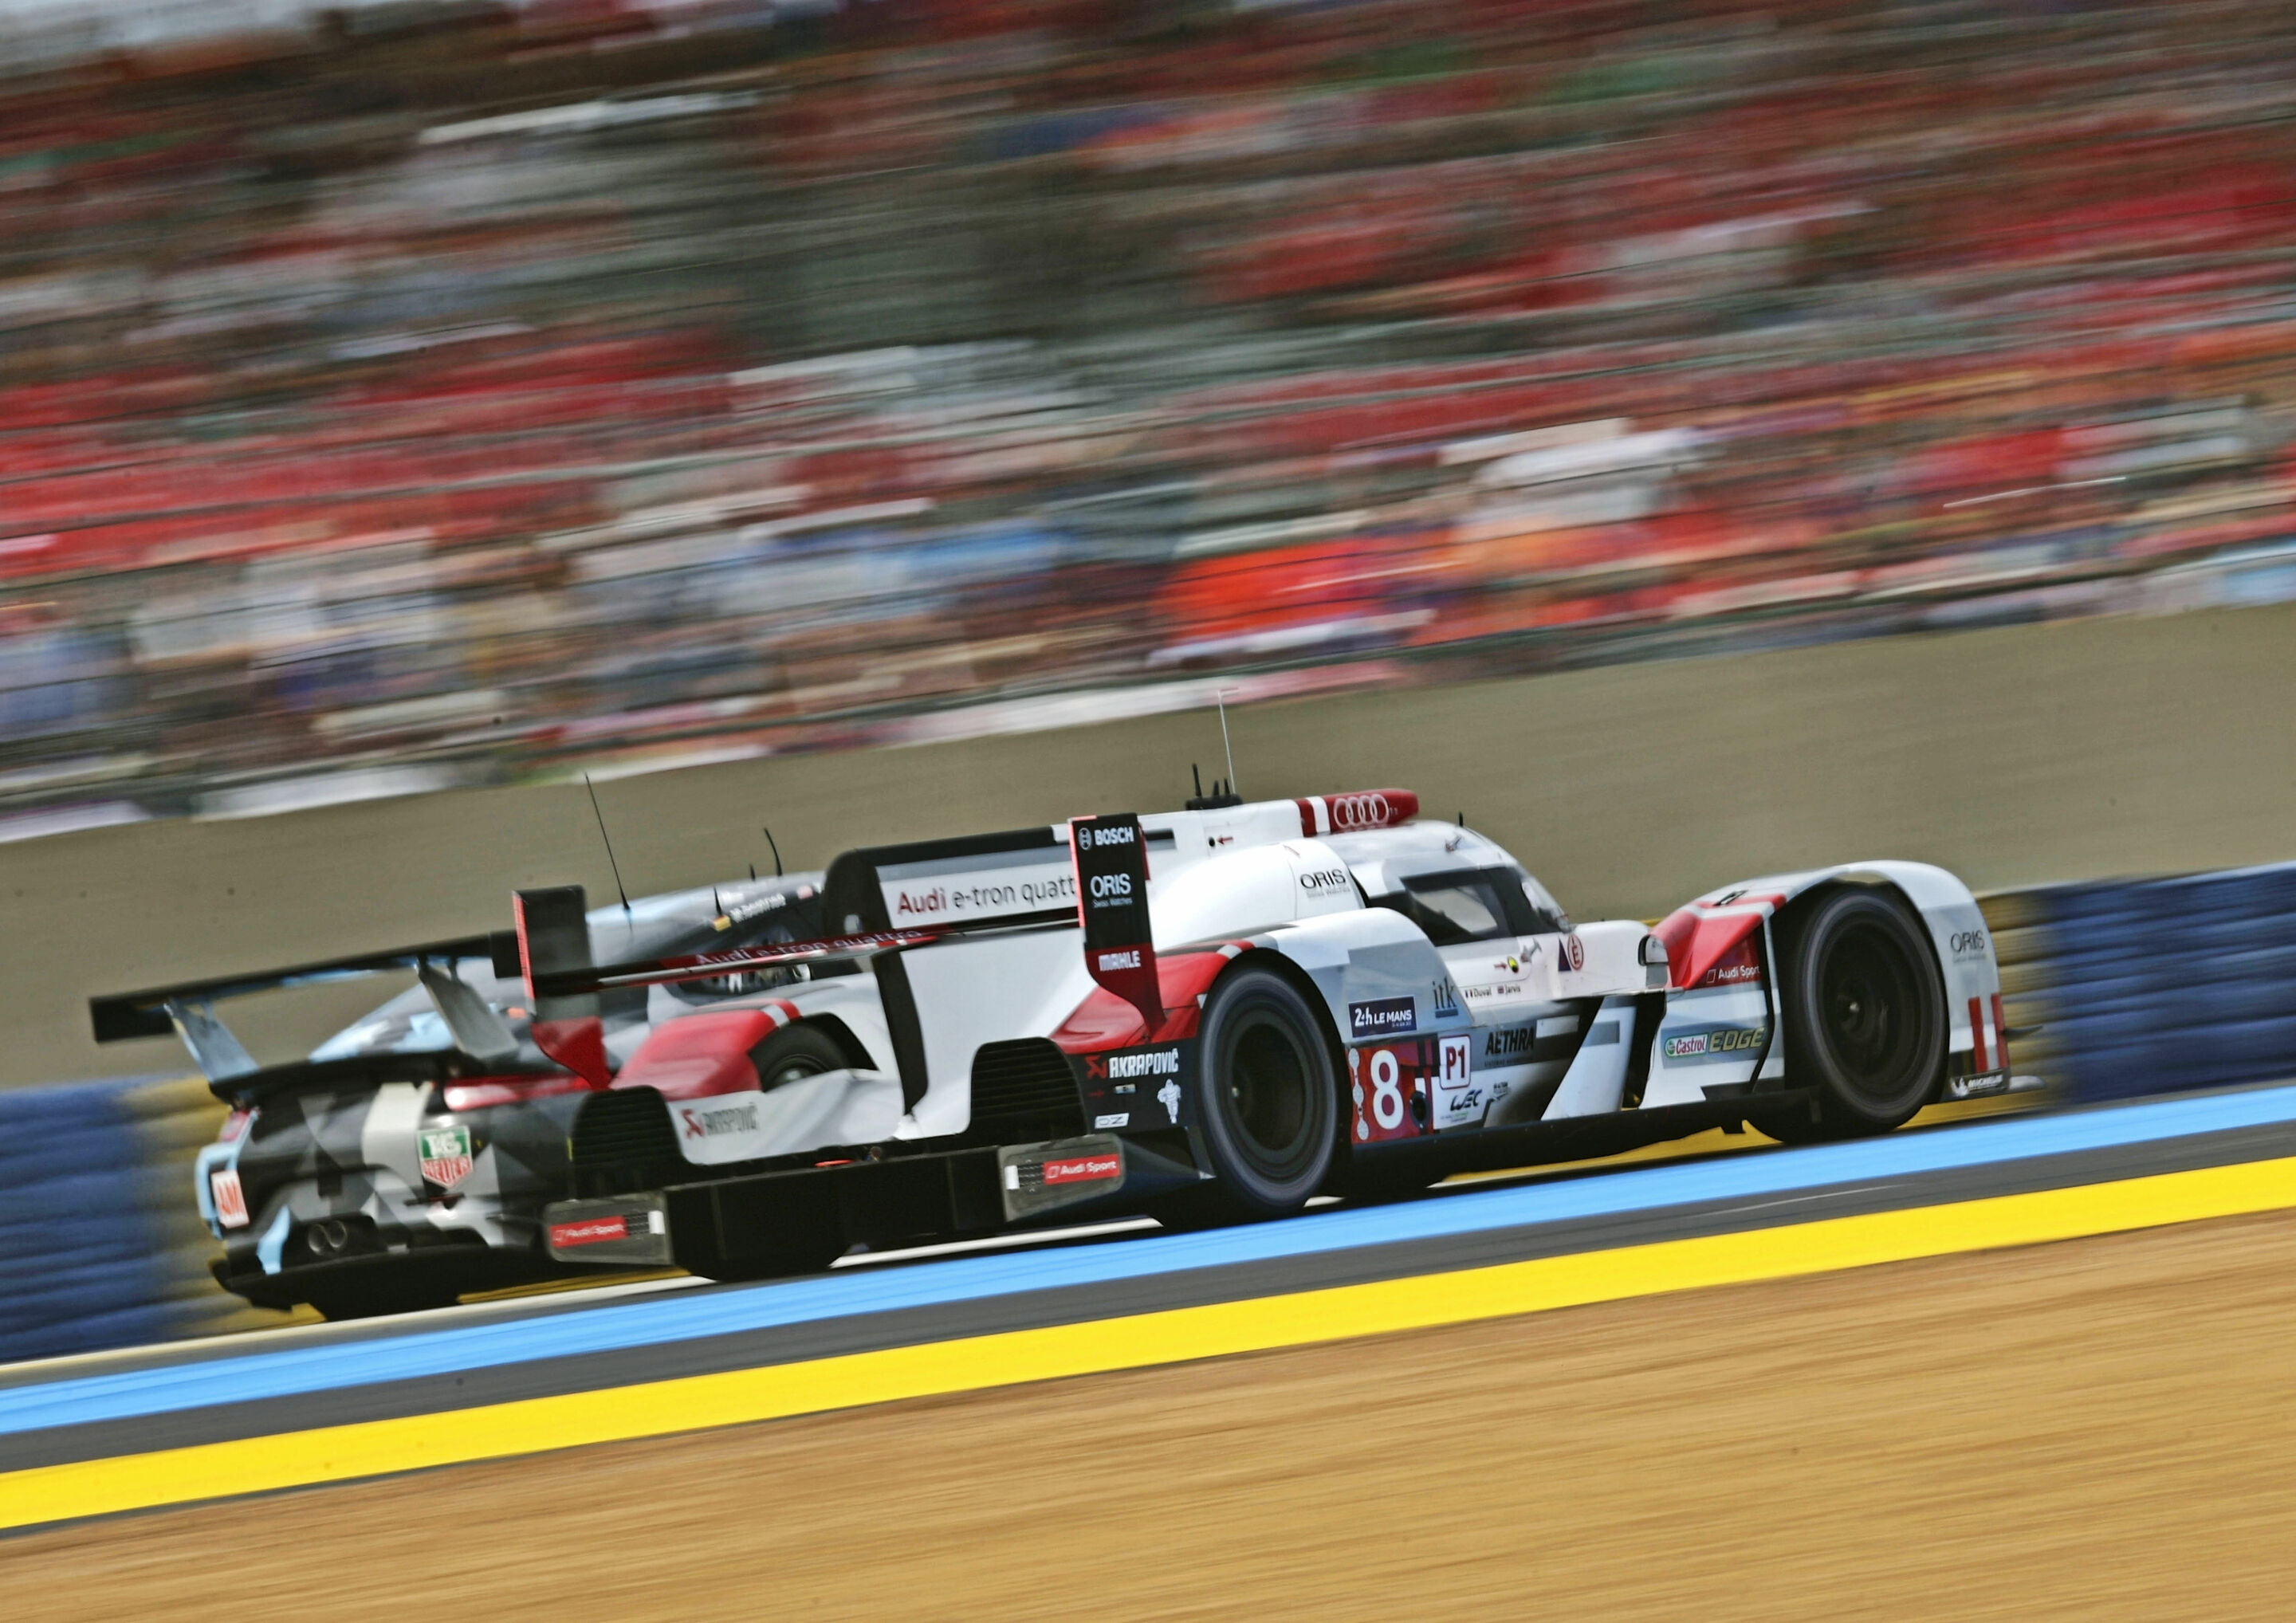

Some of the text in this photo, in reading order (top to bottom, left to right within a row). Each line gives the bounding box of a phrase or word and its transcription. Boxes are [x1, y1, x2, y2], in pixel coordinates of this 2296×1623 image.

[1095, 827, 1134, 846] BOSCH
[1090, 873, 1131, 898] ORIS
[1300, 869, 1346, 889] ORIS
[897, 874, 1075, 914] Audi e-tron quatt
[694, 949, 752, 965] Audi
[833, 929, 923, 947] quattro
[1950, 929, 1985, 952] ORIS
[1098, 950, 1141, 972] MAHLE
[1718, 965, 1760, 980] Audi Sport
[1433, 976, 1458, 1009] itk
[1473, 987, 1492, 997] Duval
[1374, 1012, 1386, 1024] LE
[1386, 1009, 1412, 1023] MANS
[1485, 1027, 1534, 1056] AETHRA
[1676, 1026, 1766, 1055] Castrol EDGE
[1445, 1044, 1465, 1080] P1
[1370, 1049, 1404, 1130] 8
[1450, 1089, 1483, 1111] WEC
[1060, 1160, 1116, 1175] Audi Sport
